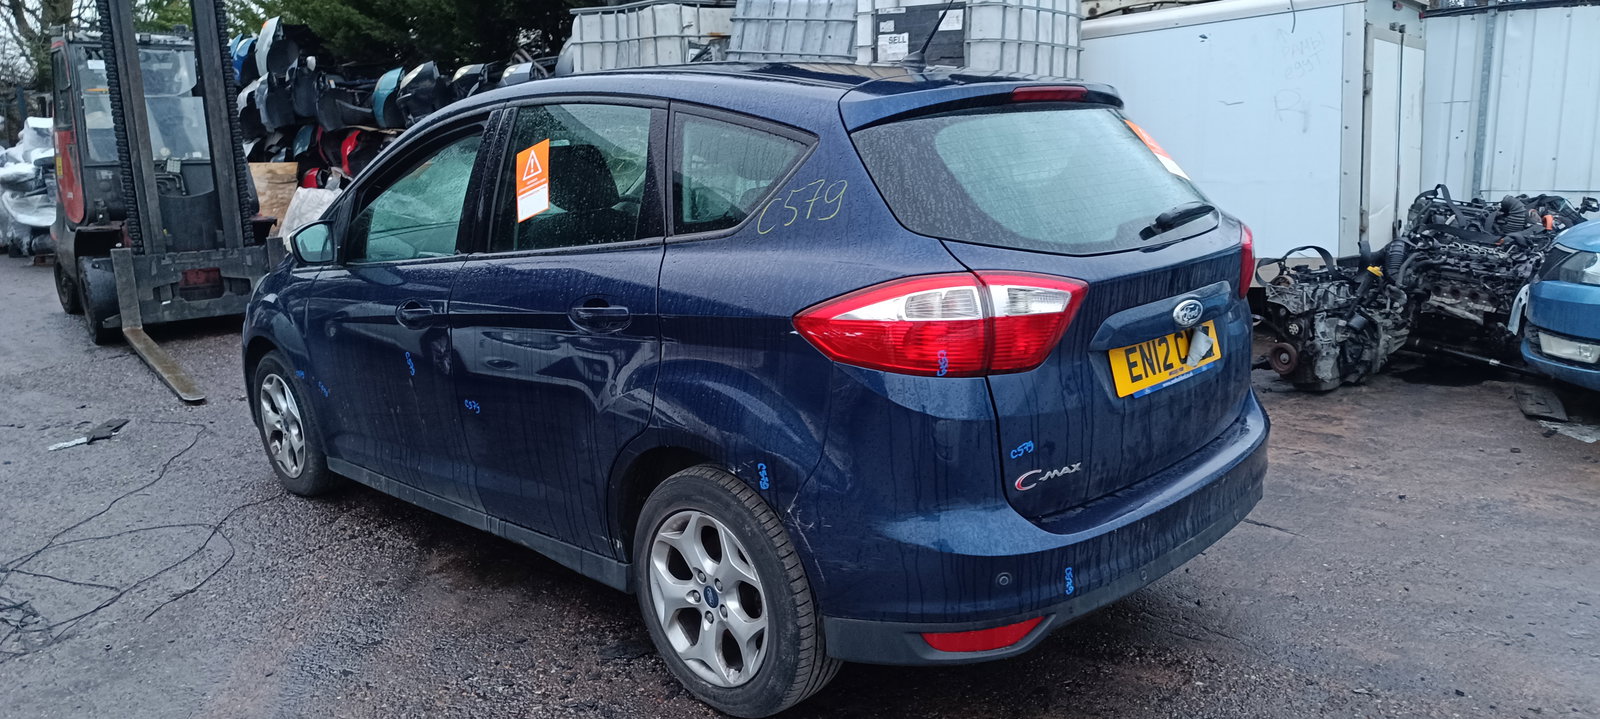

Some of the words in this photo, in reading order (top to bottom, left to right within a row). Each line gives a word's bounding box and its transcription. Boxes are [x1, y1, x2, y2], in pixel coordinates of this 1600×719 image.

[888, 35, 908, 45] SELL
[757, 179, 848, 235] C579
[1124, 337, 1174, 384] EN12
[1010, 440, 1034, 459] C579
